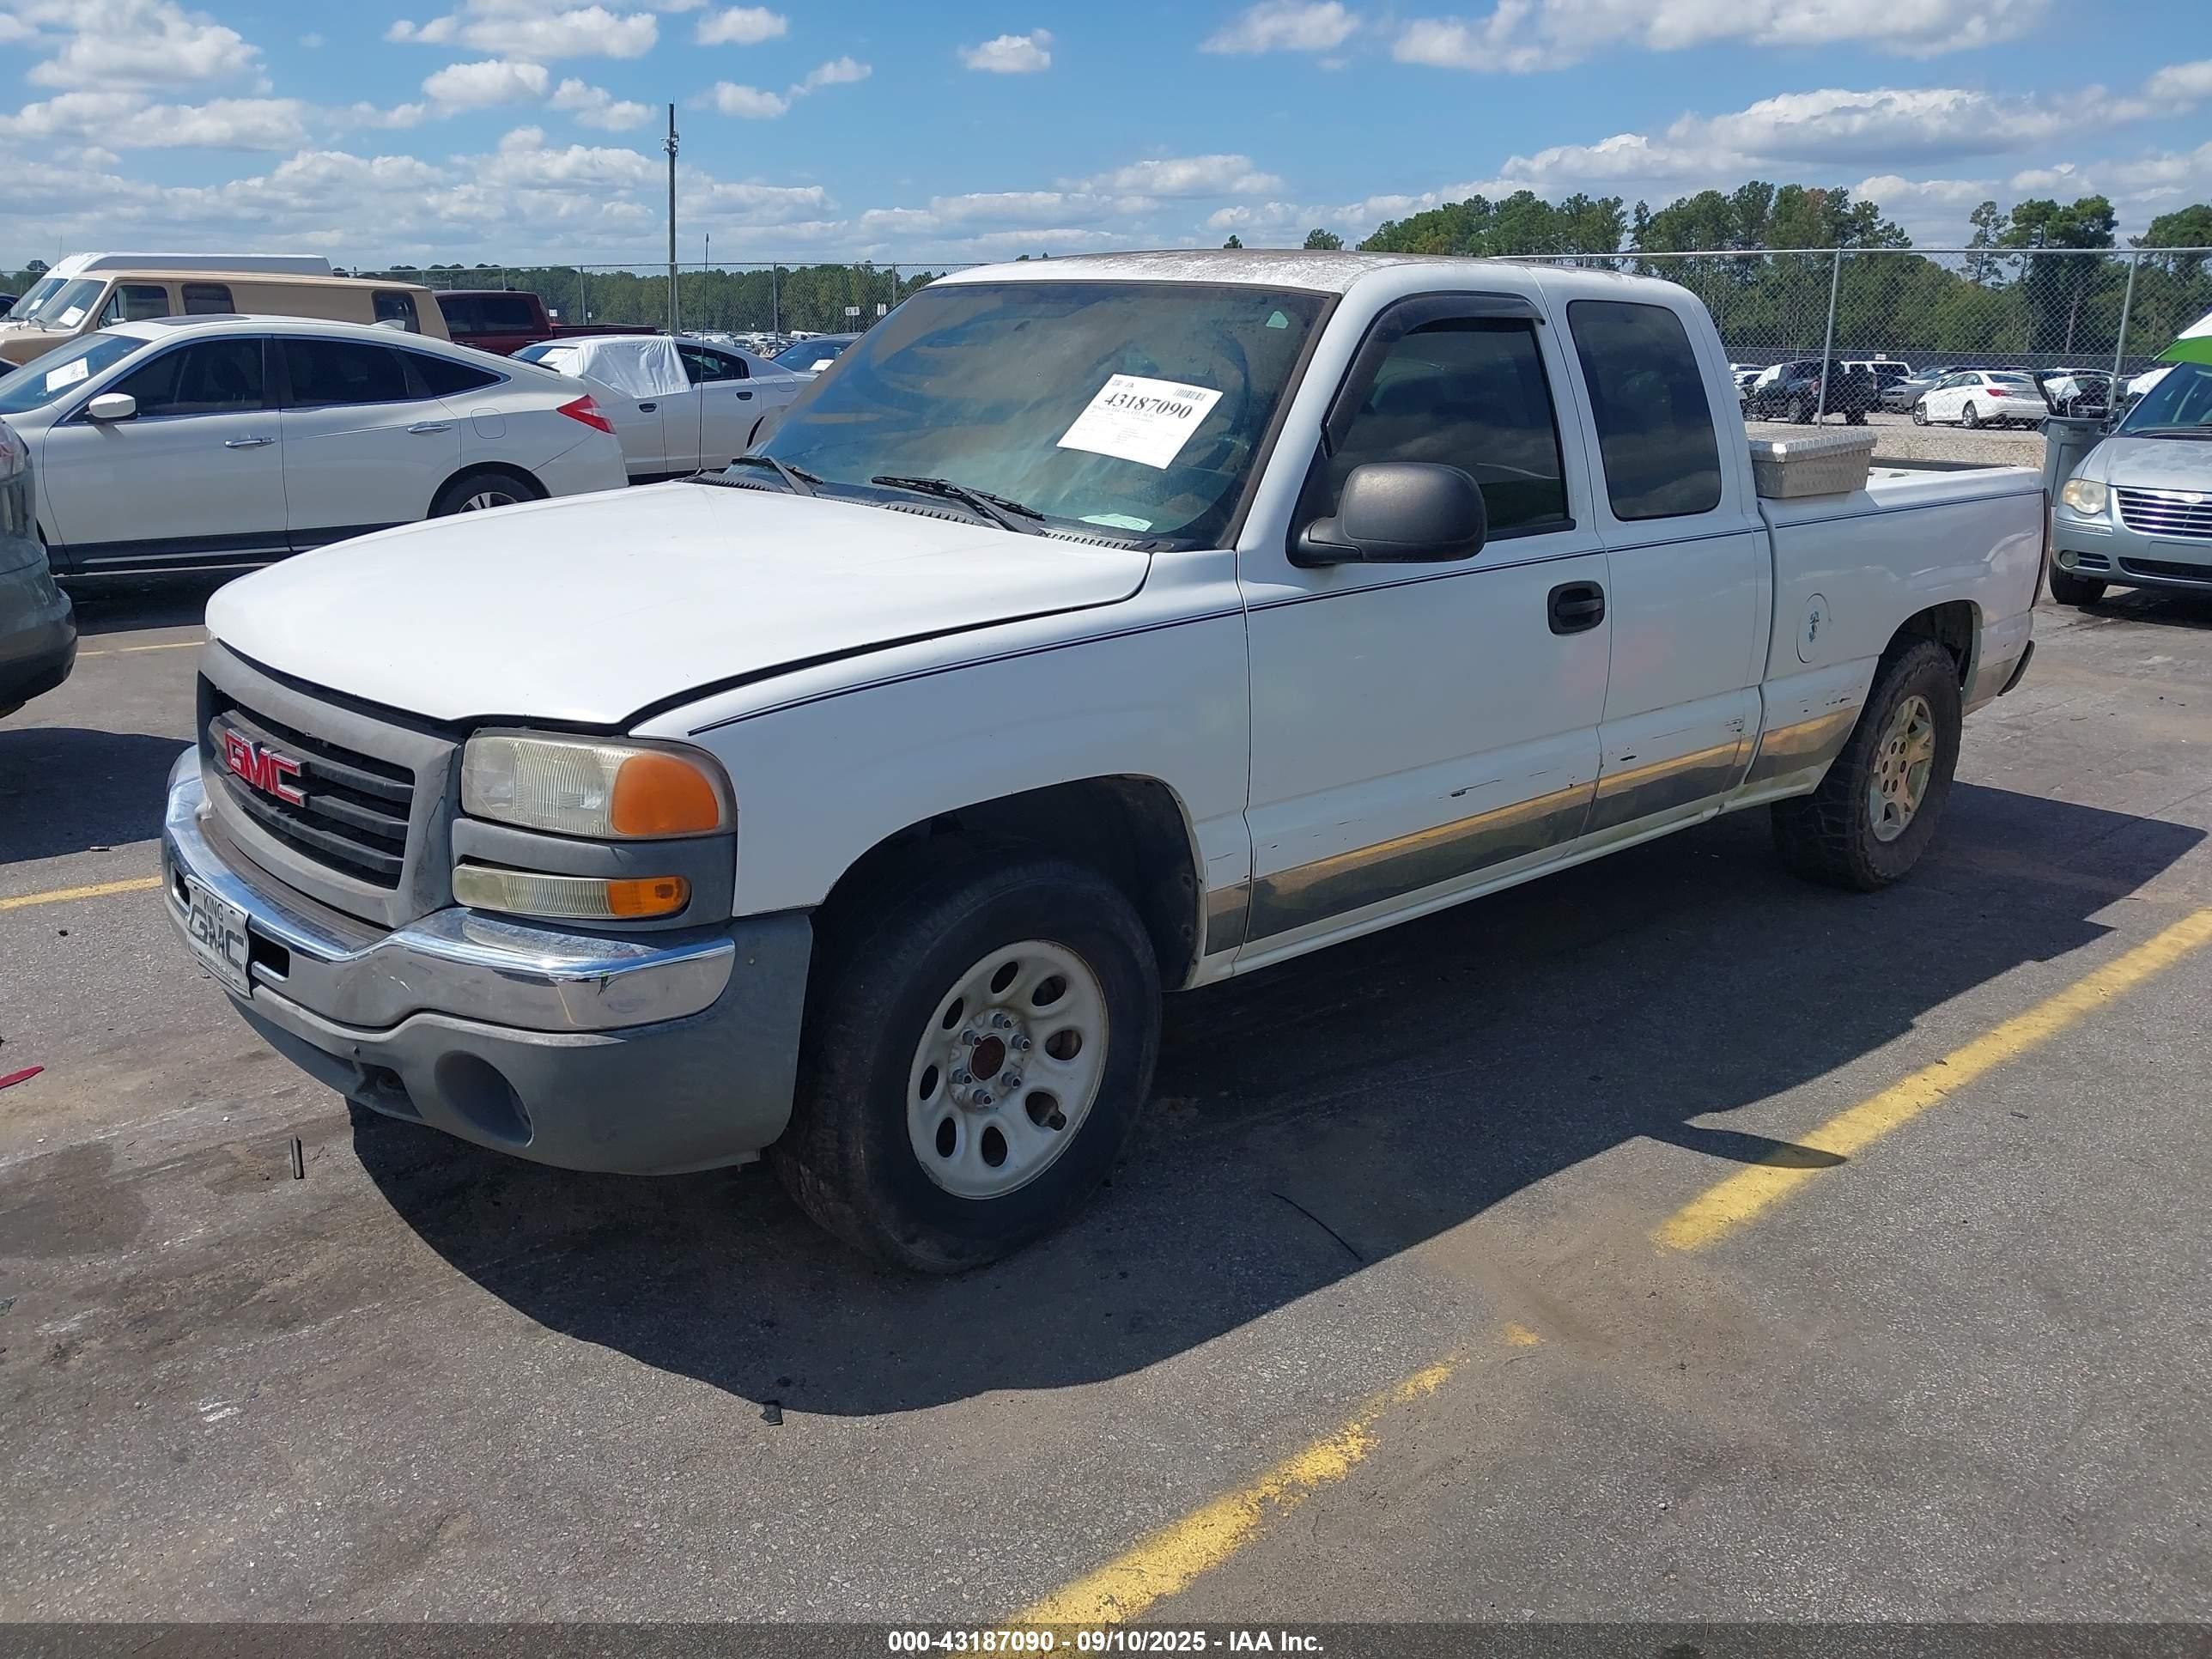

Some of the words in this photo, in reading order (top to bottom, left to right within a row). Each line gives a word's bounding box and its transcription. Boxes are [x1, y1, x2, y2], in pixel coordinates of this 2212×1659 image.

[1104, 392, 1193, 419] 43187090
[224, 728, 307, 807] GMC
[204, 892, 224, 921] KING
[189, 904, 244, 973] GMC
